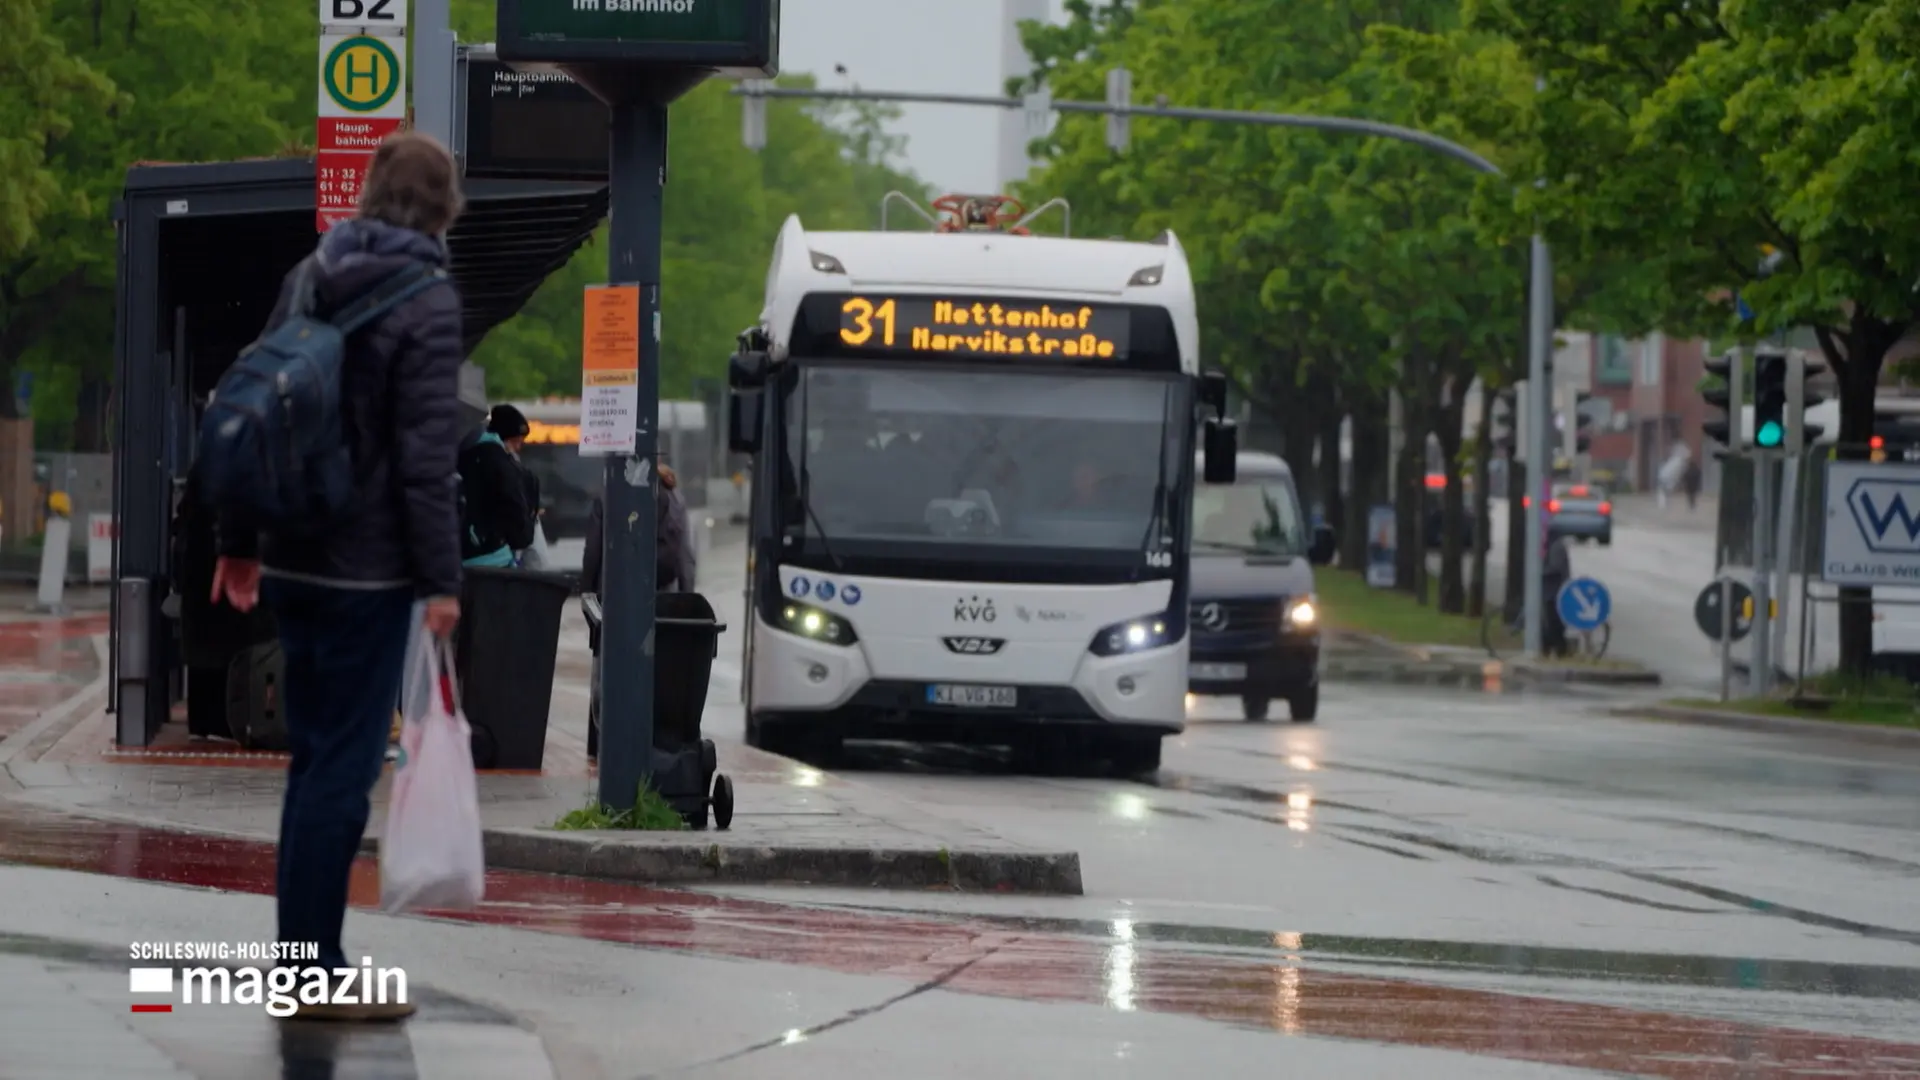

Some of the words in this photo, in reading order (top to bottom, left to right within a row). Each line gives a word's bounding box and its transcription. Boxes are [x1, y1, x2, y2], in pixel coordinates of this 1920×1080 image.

[332, 0, 395, 19] B2
[346, 53, 378, 95] H
[335, 122, 374, 134] Haupt-
[321, 168, 334, 179] 31
[342, 168, 356, 180] 32
[320, 181, 333, 192] 61
[341, 181, 355, 193] 62
[320, 194, 342, 205] 31N
[840, 298, 896, 346] 31
[934, 300, 1092, 330] Mettenhof
[1146, 551, 1172, 568] 168
[954, 605, 997, 623] KVG
